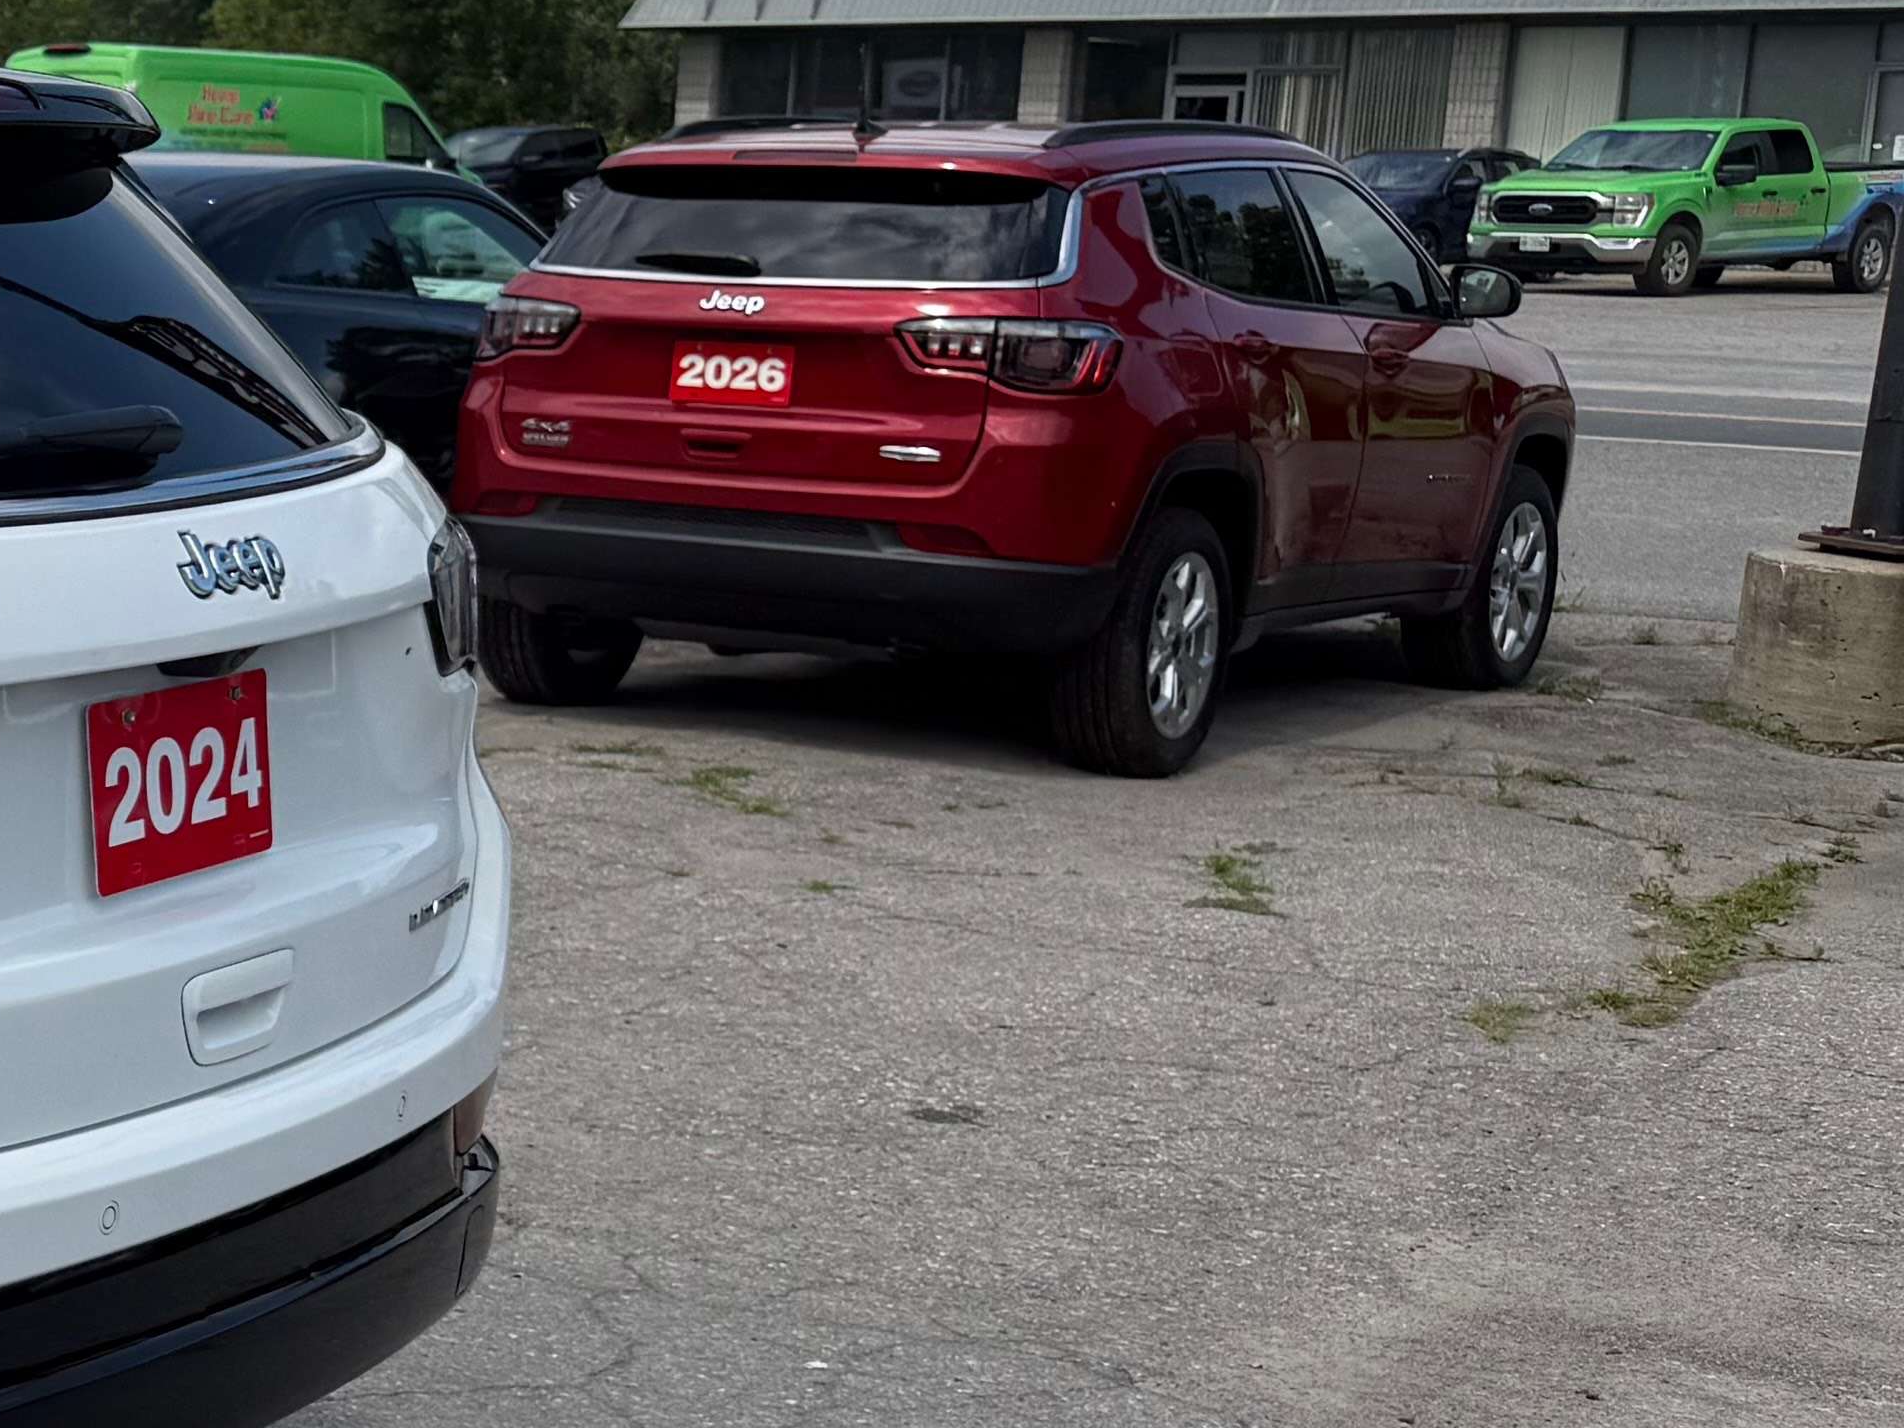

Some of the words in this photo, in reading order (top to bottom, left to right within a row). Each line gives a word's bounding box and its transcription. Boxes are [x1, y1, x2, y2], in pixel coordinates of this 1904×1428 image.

[699, 289, 765, 315] Jeep
[676, 353, 785, 393] 2026
[176, 529, 286, 601] Jeep
[103, 716, 263, 848] 2024
